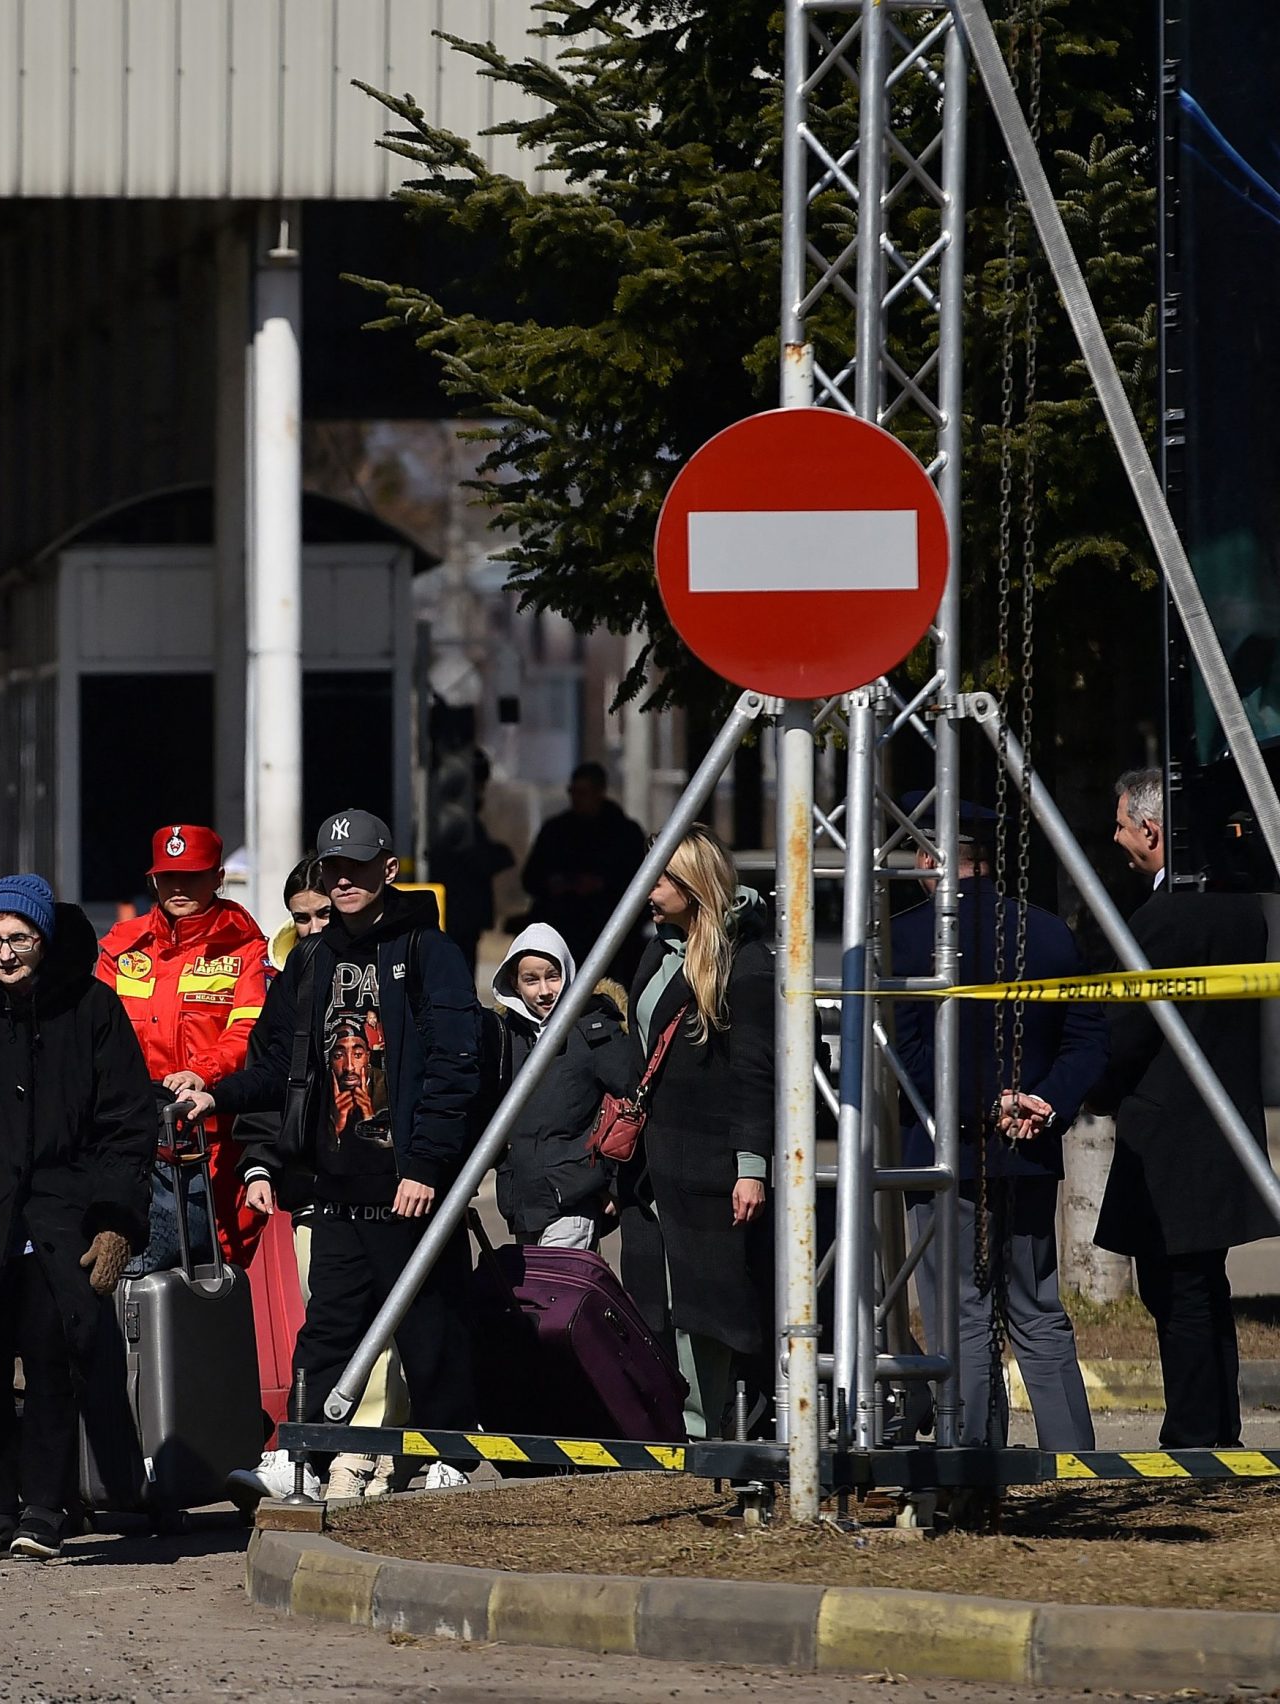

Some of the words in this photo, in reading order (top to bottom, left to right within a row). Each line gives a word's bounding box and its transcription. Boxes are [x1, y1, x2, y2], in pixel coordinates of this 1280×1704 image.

[196, 964, 234, 974] ARAD
[1124, 980, 1143, 998] NU
[1147, 977, 1207, 997] TRECETI
